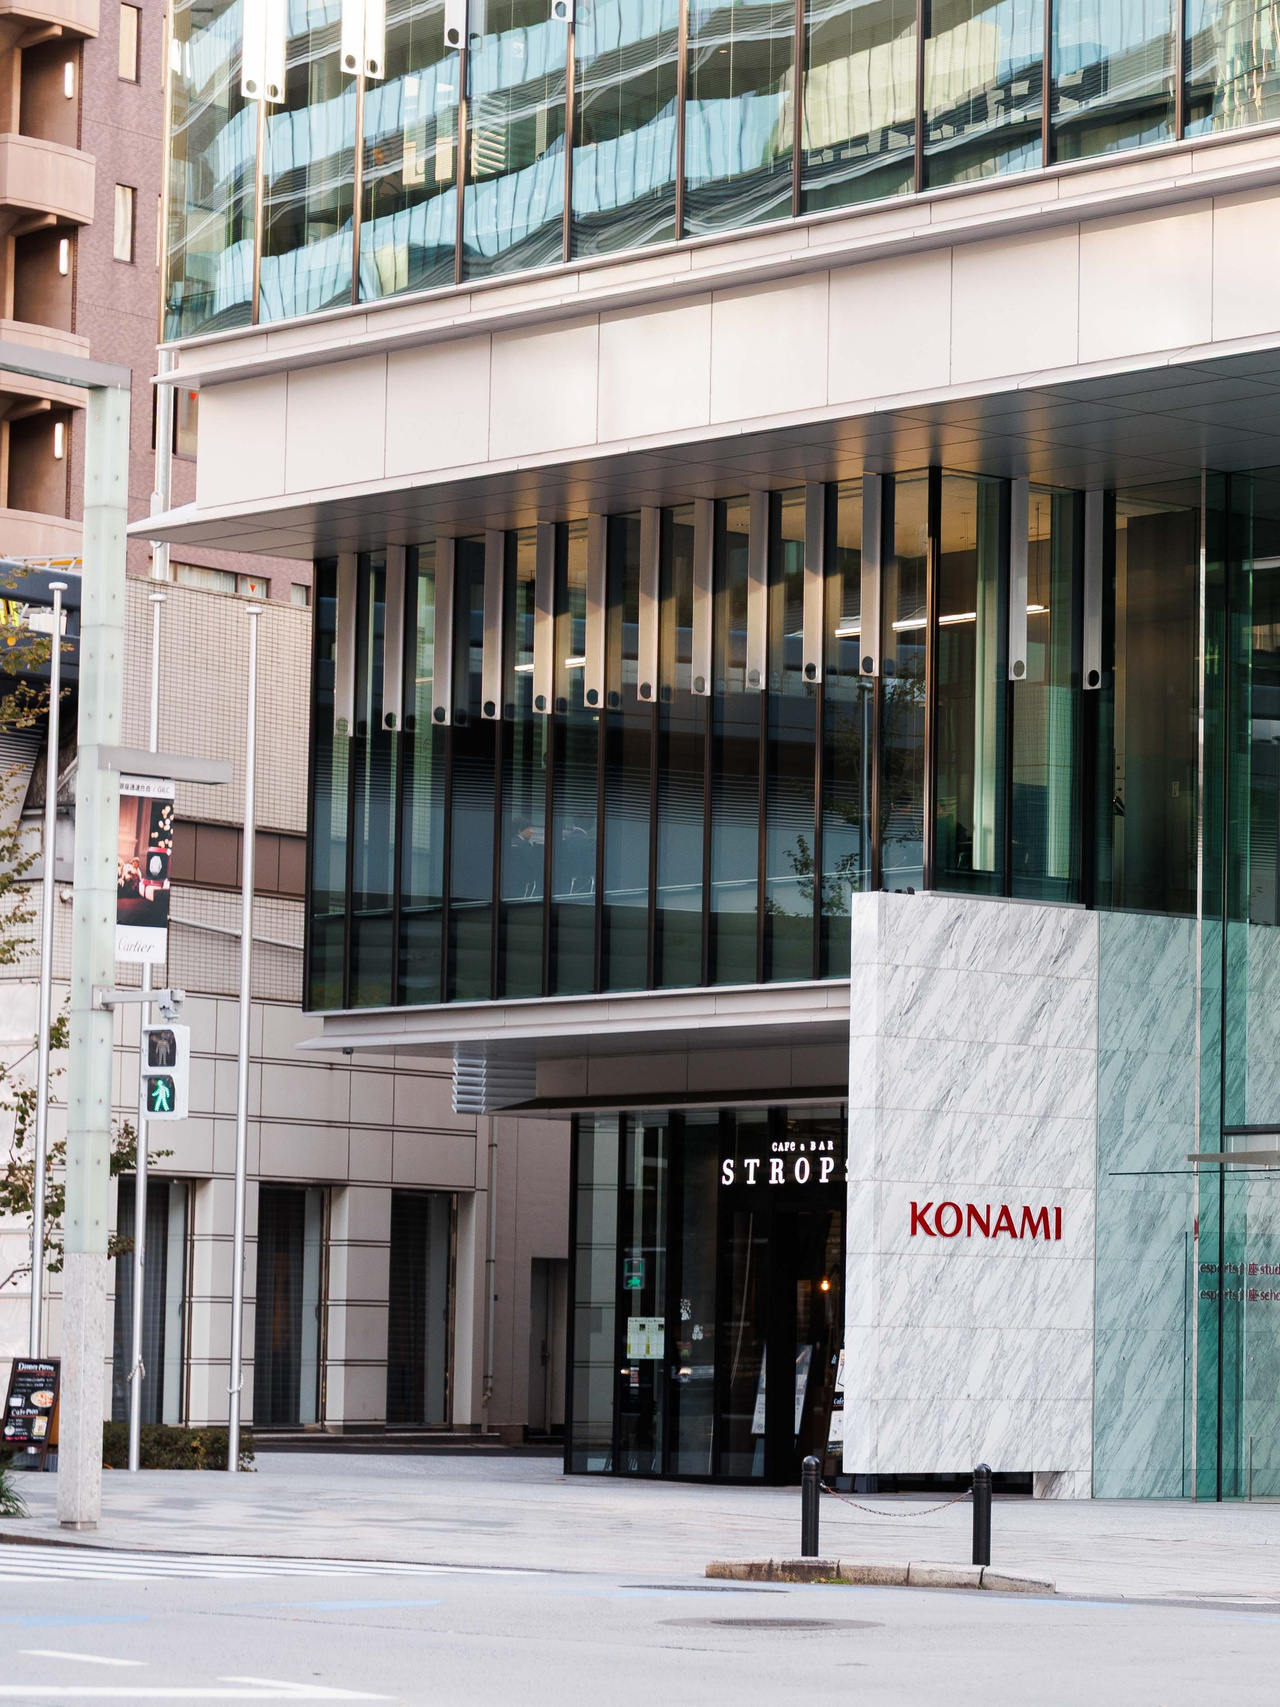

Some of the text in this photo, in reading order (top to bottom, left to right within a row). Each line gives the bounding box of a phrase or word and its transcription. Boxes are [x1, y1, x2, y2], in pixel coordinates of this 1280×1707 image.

[118, 935, 155, 953] Cartier
[810, 1140, 834, 1151] BAR
[721, 1157, 848, 1185] STROP
[910, 1201, 1062, 1240] KONAMI
